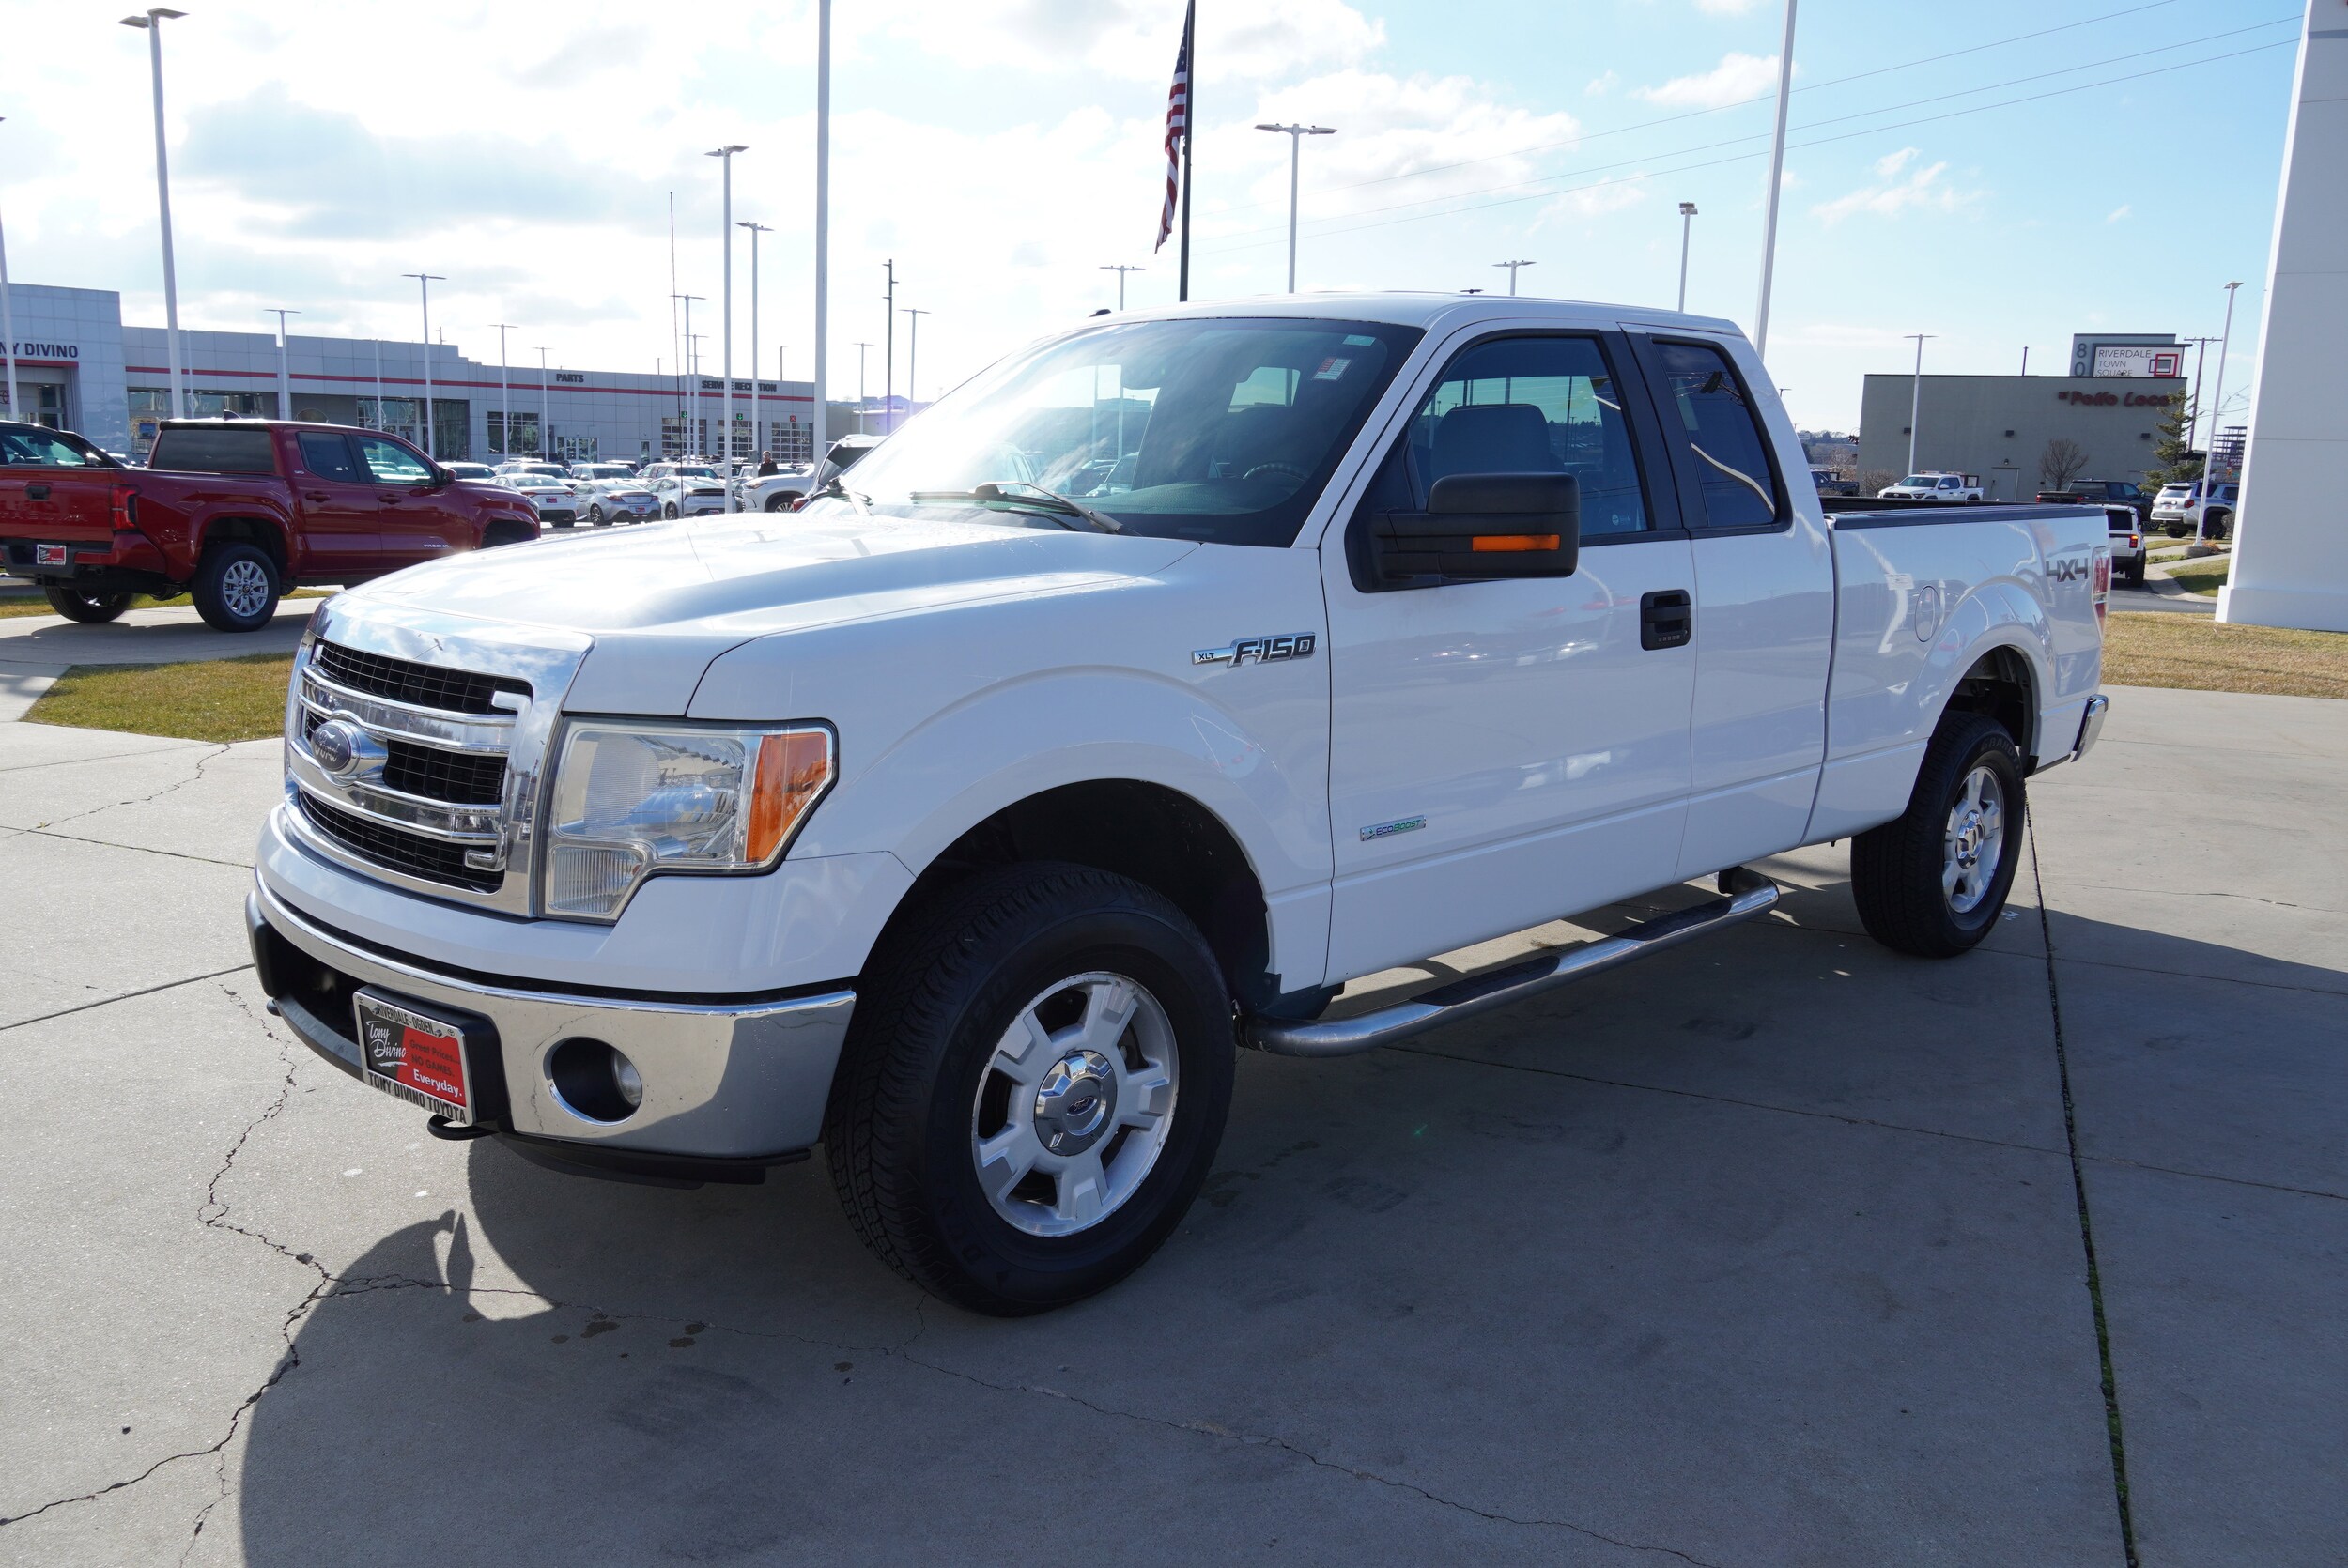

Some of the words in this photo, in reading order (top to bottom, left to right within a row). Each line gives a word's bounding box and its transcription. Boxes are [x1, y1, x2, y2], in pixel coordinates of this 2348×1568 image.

[24, 343, 78, 358] DIVINO
[2098, 349, 2152, 359] RIVERDALE
[2098, 360, 2126, 368] TOWN
[556, 373, 584, 383] PARTS
[1230, 633, 1316, 666] F-150
[377, 1004, 409, 1028] RIVERDALE
[413, 1018, 434, 1036] OGDEN
[366, 1020, 391, 1044] Tony
[370, 1038, 408, 1058] Divino
[409, 1038, 430, 1054] Great
[411, 1054, 424, 1066] NO
[413, 1068, 463, 1098] Everyday.
[368, 1073, 392, 1093] TONY
[394, 1084, 425, 1108] DIVINO
[427, 1096, 467, 1124] TOYOTA
[1074, 1098, 1090, 1112] Ford
